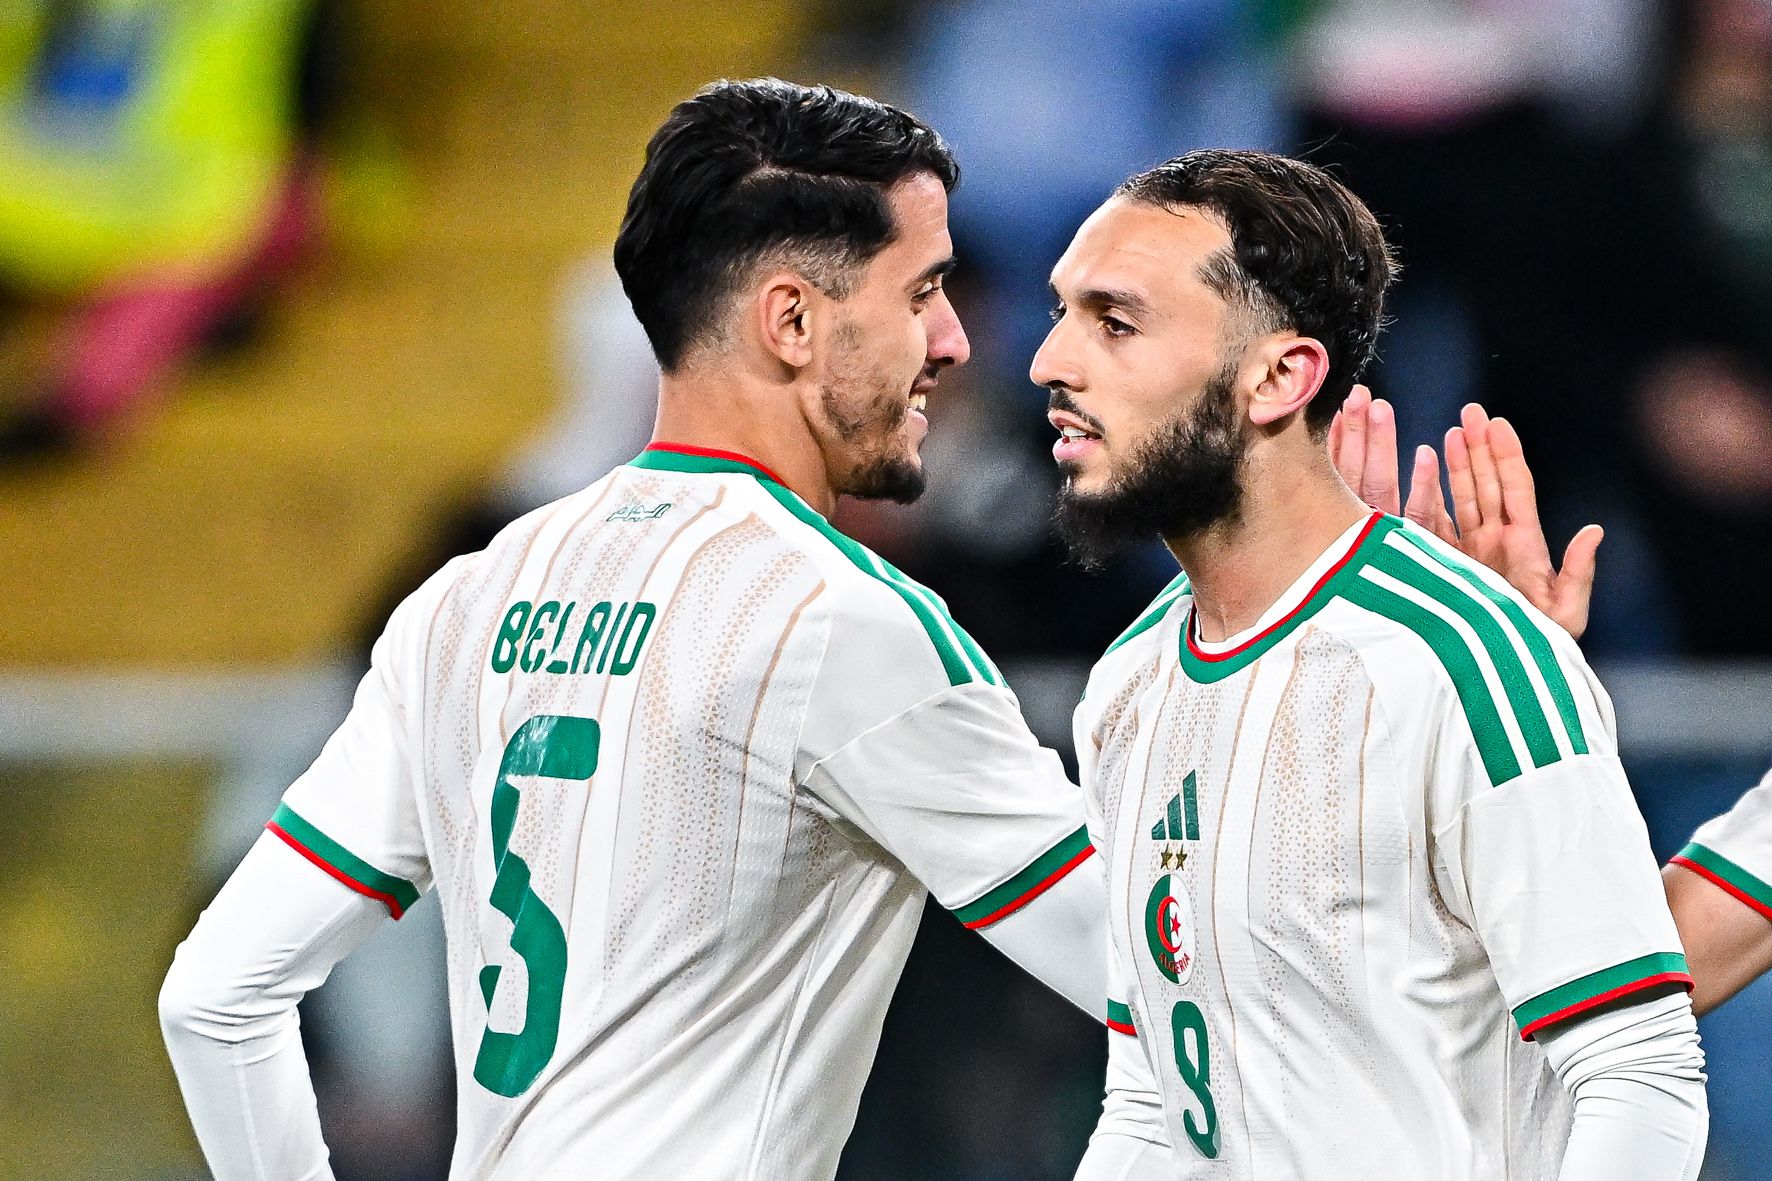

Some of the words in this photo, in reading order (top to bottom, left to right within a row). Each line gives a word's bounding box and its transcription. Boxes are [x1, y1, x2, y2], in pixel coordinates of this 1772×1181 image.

[492, 600, 656, 676] BELAID
[473, 714, 601, 1098] 5
[1171, 1000, 1221, 1159] 9
